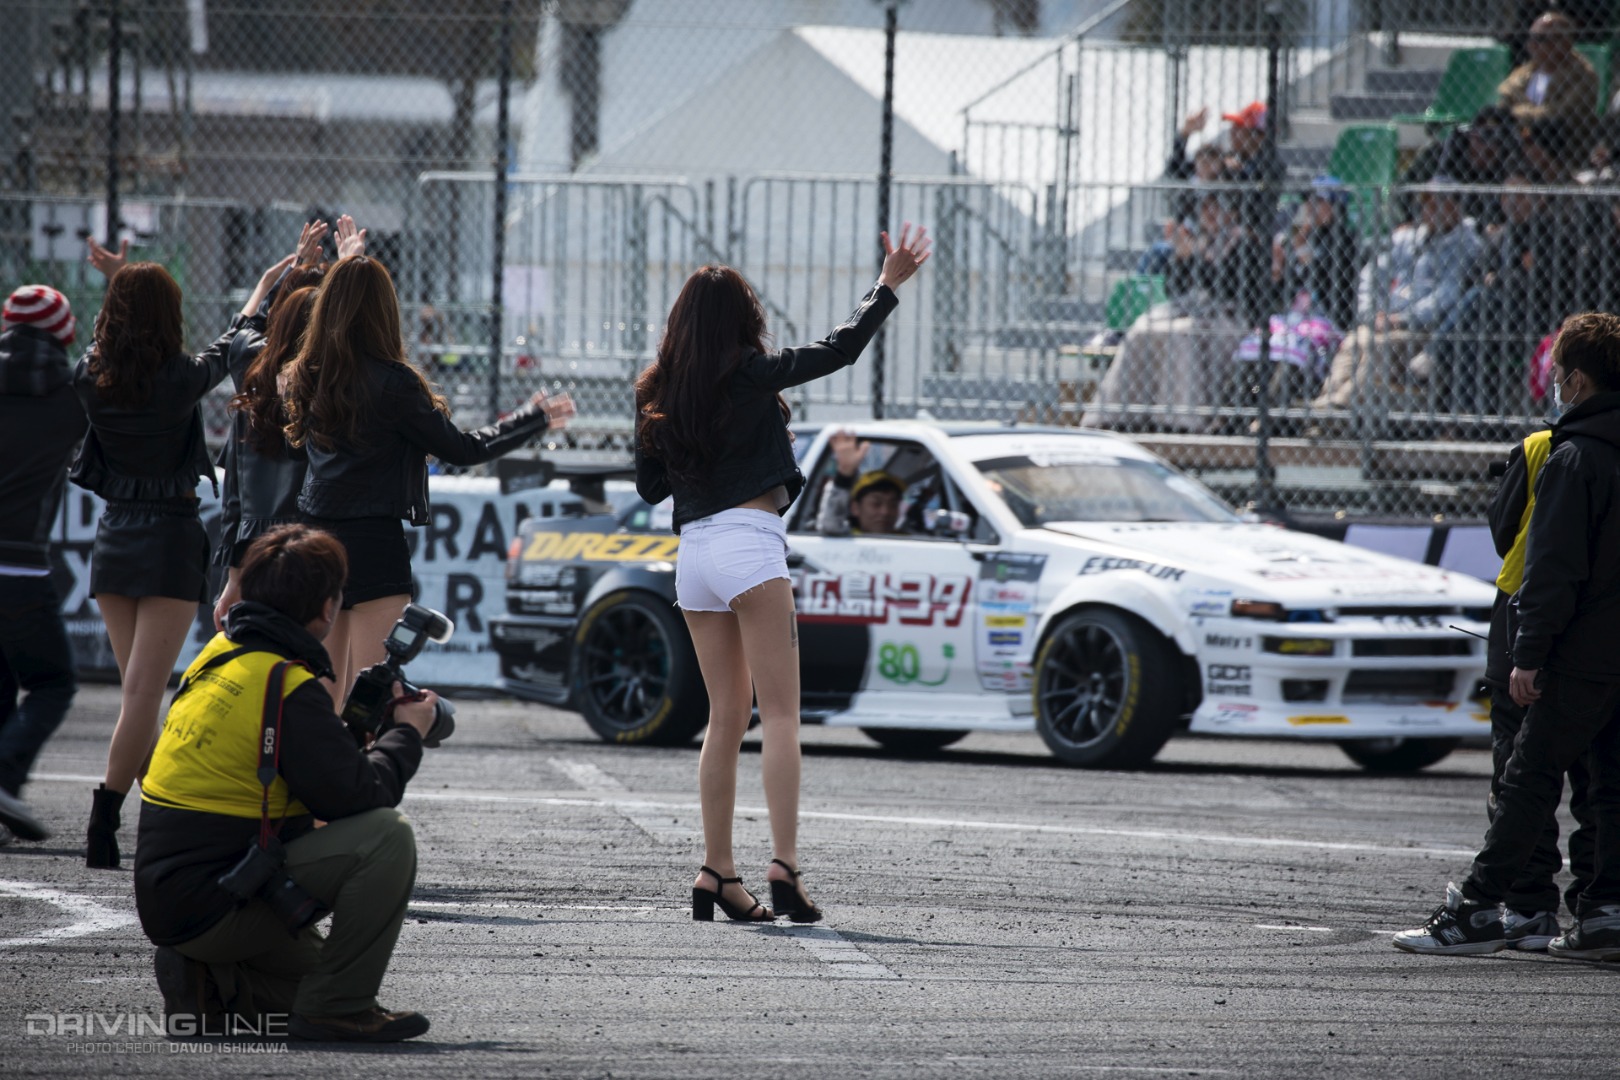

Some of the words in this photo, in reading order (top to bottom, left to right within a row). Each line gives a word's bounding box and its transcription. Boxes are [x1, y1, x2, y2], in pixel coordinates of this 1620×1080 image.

[523, 531, 681, 562] DIREZZ
[878, 641, 921, 681] 80
[264, 727, 275, 755] EOS
